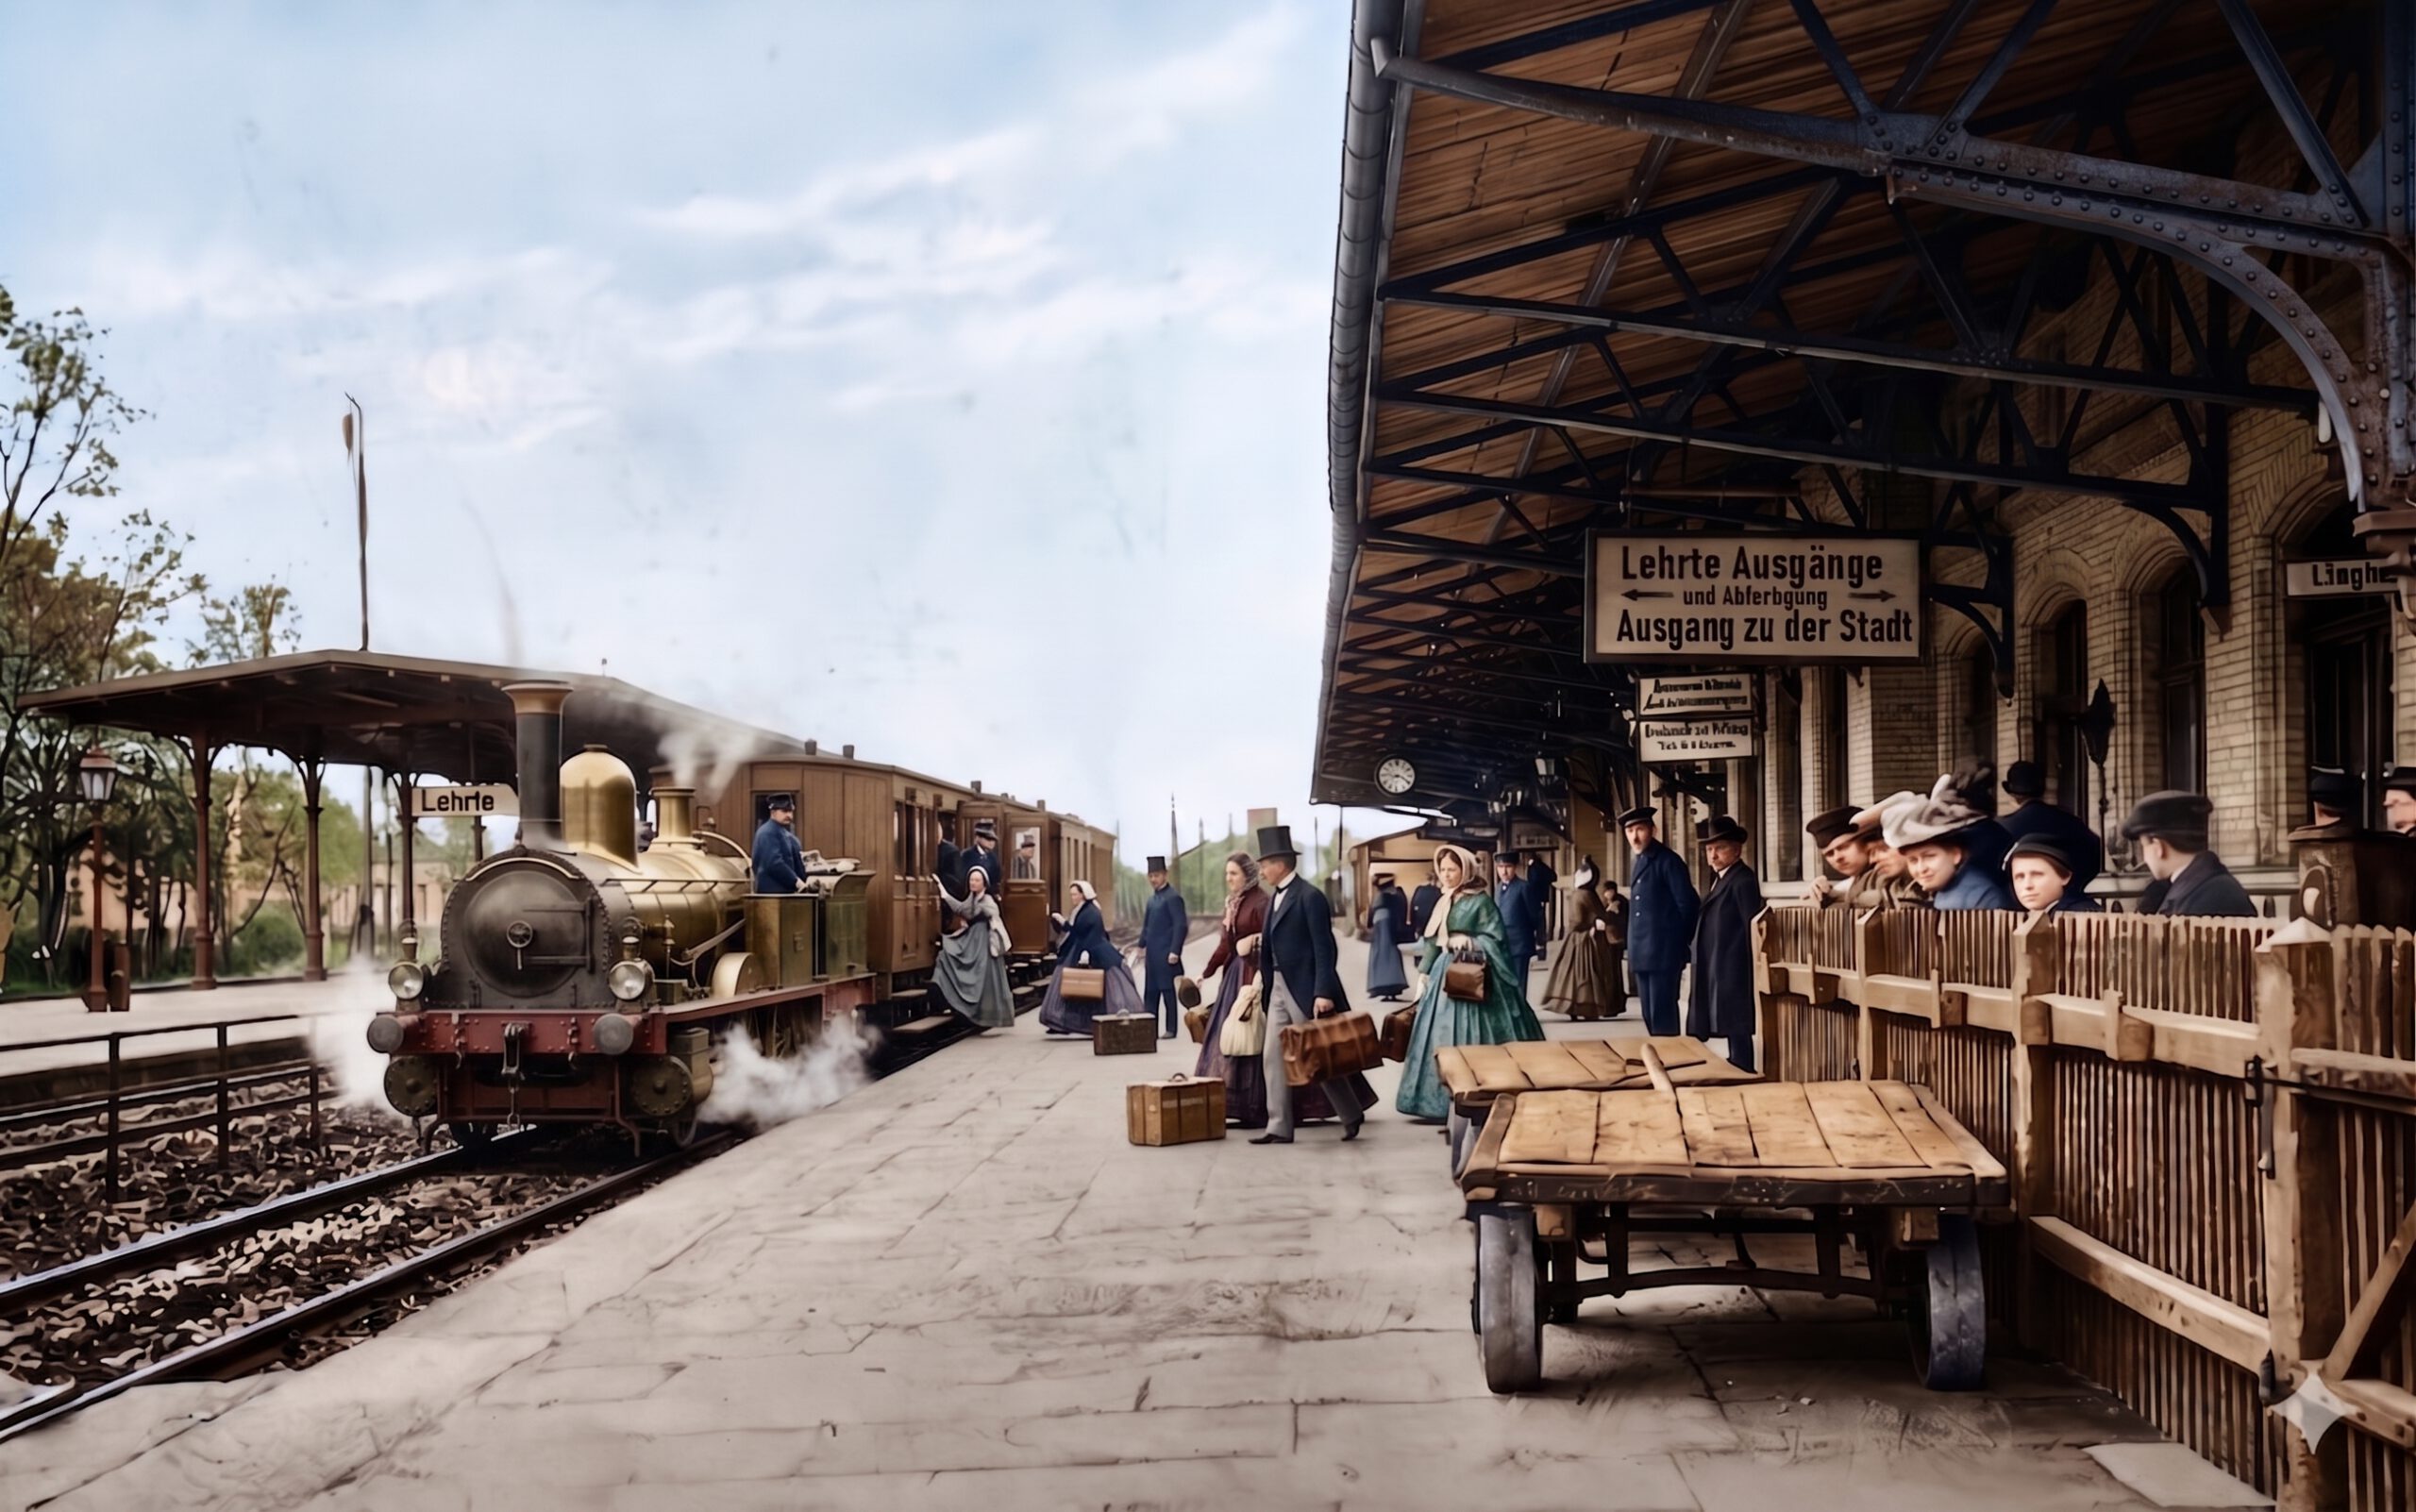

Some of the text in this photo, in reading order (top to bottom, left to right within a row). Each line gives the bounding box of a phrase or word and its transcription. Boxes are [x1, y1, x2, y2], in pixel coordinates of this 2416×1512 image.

[1622, 545, 1883, 588] Lehrte Ausgänge
[1684, 584, 1716, 605] und
[1617, 609, 1913, 650] Ausgang zu der Stadt
